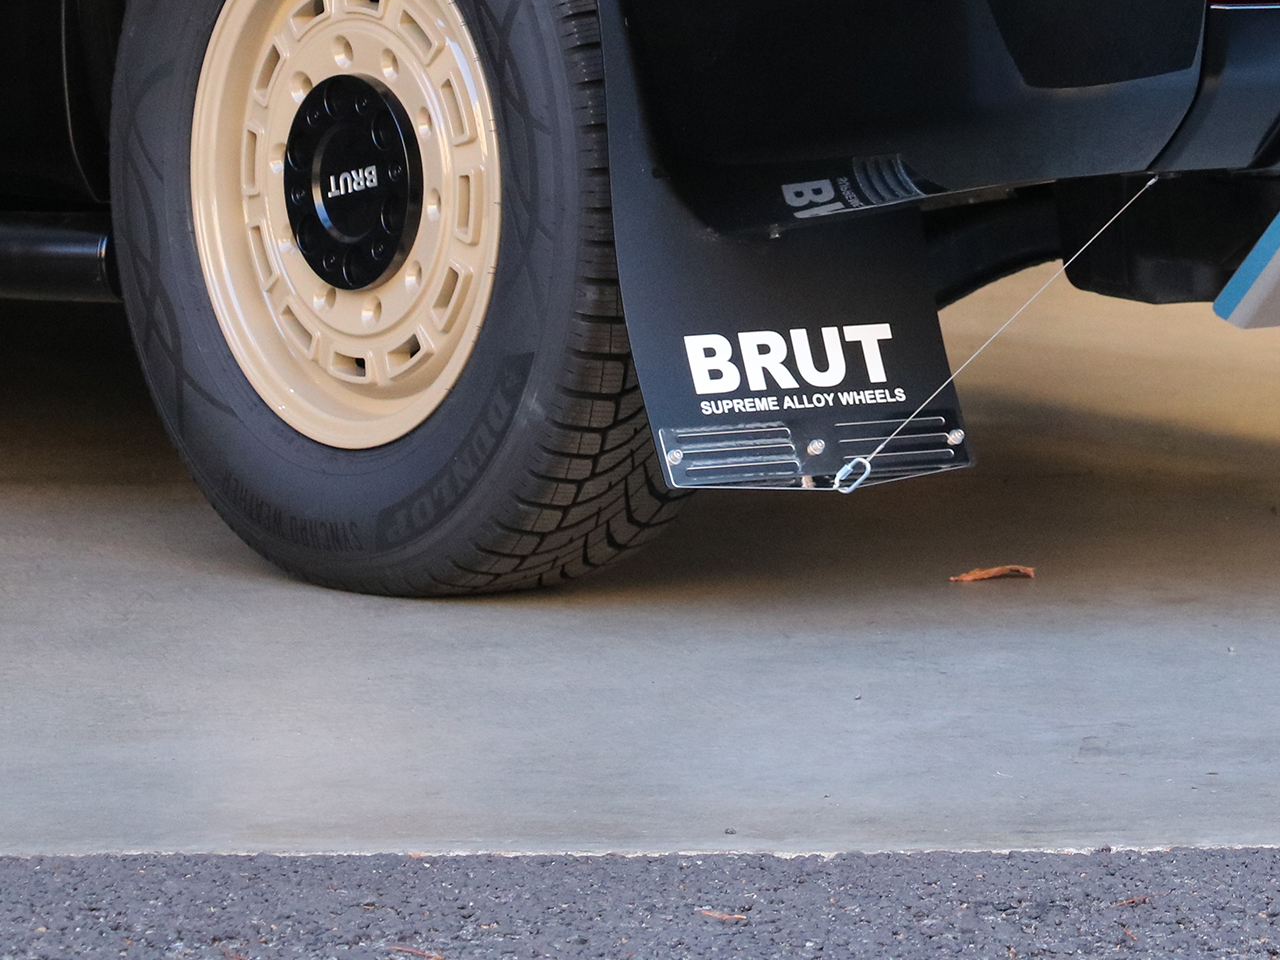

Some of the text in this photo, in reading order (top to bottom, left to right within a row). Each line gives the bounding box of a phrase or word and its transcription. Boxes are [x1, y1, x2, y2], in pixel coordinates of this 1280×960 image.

[327, 164, 379, 198] BRUT
[683, 323, 893, 395] BRUT
[700, 388, 907, 415] SUPREME ALLOY WHEELS
[385, 385, 512, 543] DUNLOP
